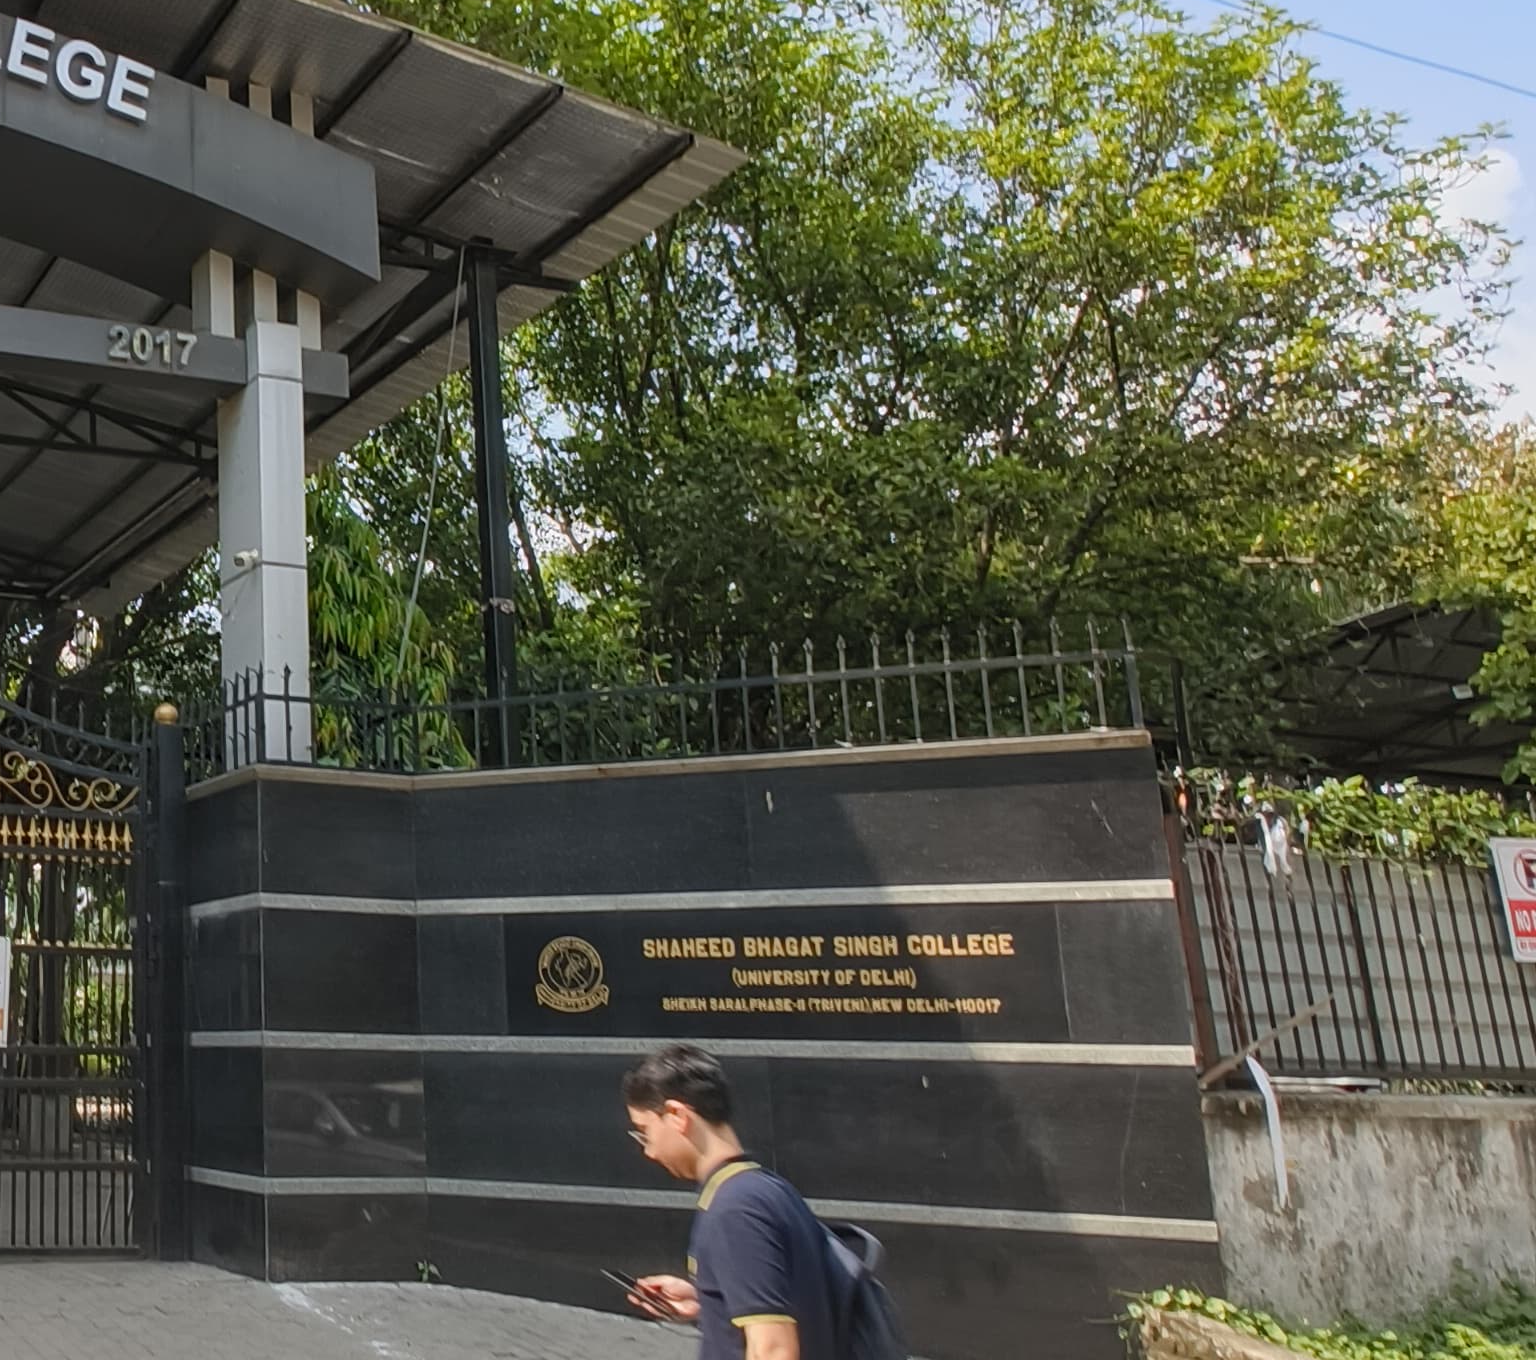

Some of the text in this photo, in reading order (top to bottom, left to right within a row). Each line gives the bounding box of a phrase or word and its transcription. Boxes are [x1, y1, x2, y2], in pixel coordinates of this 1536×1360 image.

[108, 325, 199, 366] 2017
[1514, 909, 1531, 933] NO
[643, 933, 1015, 959] SHAHEED BHAGAT SINGH COLLEGE
[732, 966, 917, 990] (UNIVERSITY OF DELHI)
